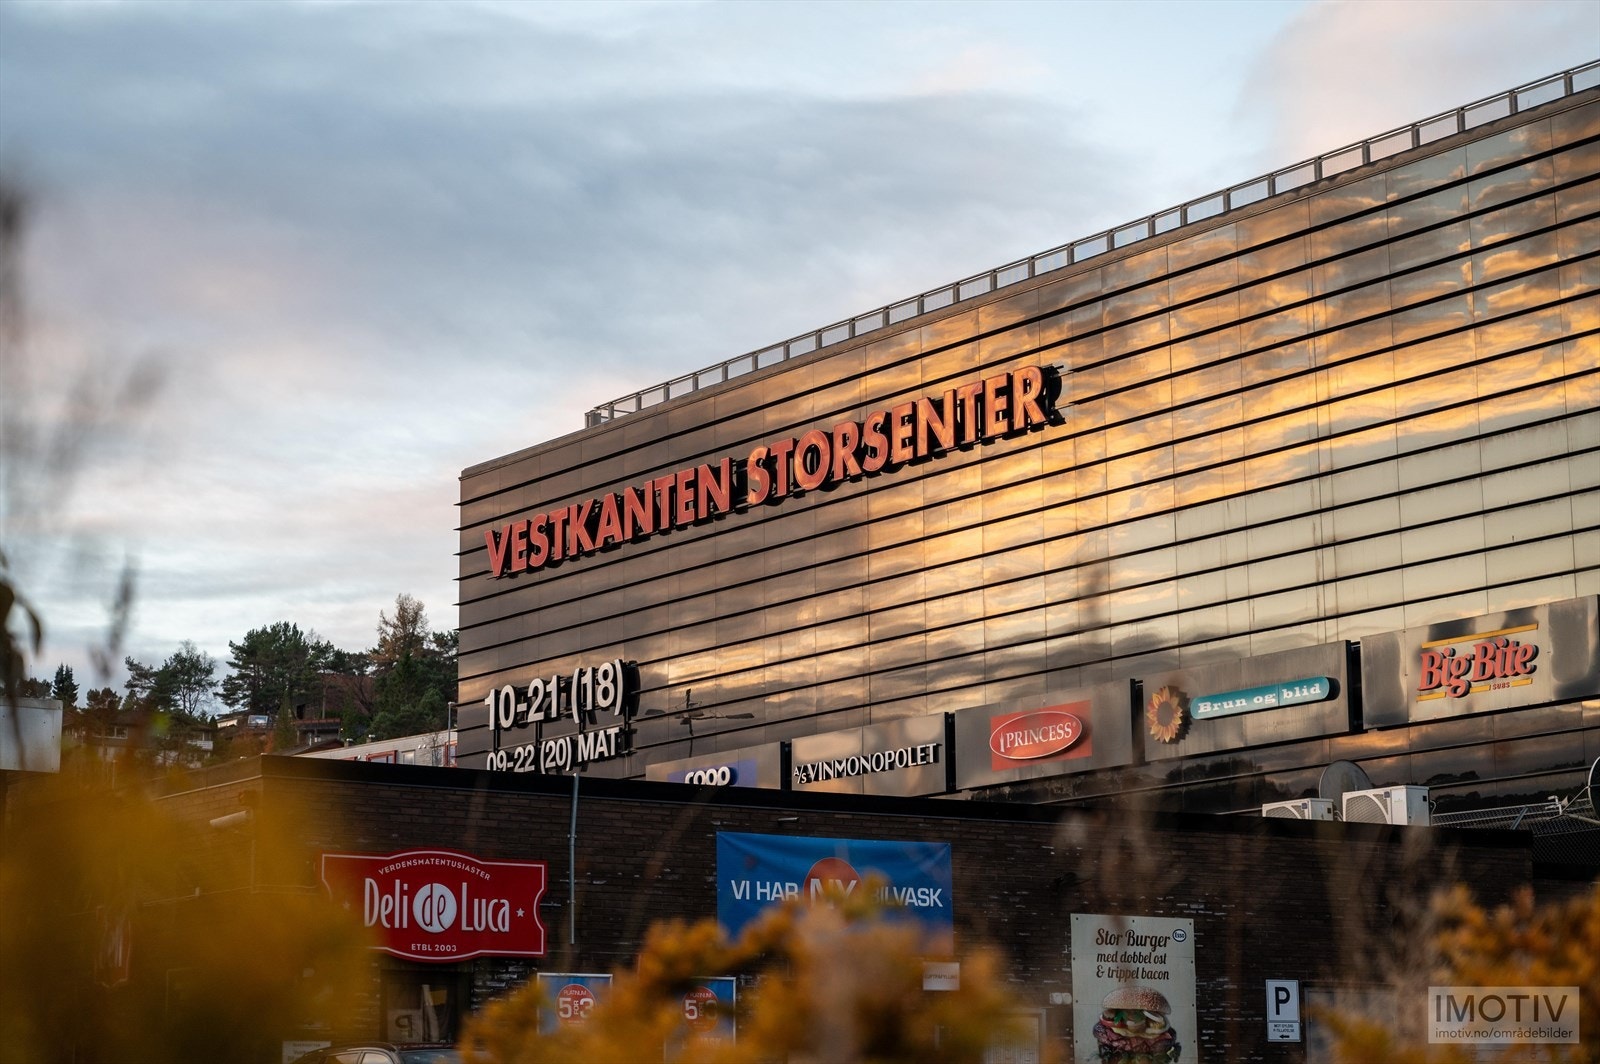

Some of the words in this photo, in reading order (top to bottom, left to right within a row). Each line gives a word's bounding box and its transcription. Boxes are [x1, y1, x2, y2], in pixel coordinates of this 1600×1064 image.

[484, 457, 733, 578] VESTKANTEN
[747, 366, 1048, 504] STORSENTER
[1417, 647, 1471, 698] Big
[1471, 637, 1536, 682] Bite
[484, 675, 559, 731] 10-21
[571, 659, 624, 724] (18)
[1197, 697, 1247, 714] Brun
[1252, 692, 1277, 706] og
[1281, 683, 1322, 699] blid
[1493, 682, 1511, 690] SUBS
[1004, 721, 1073, 749] PRINCESS
[540, 736, 573, 775] (20)
[577, 727, 620, 763] MAT
[807, 743, 938, 782] VINMONOPOLET
[378, 858, 491, 881] VERDENSMATENTUSIASTER
[731, 880, 750, 900] VI
[756, 881, 799, 901] HAR
[364, 877, 408, 930] Deli
[421, 883, 448, 930] de
[461, 882, 510, 933] Luca
[411, 943, 432, 951] ETBL
[434, 944, 457, 952] 2003
[1095, 928, 1123, 946] Stor
[1125, 929, 1171, 952] Burger
[1096, 951, 1118, 963] med
[1120, 951, 1152, 964] dobbel
[1153, 953, 1167, 965] ost
[1096, 965, 1105, 978] &
[1107, 966, 1140, 982] trippel
[1141, 967, 1170, 980] bacon
[559, 997, 572, 1018] 5
[580, 997, 594, 1019] 3
[685, 1000, 698, 1020] 5
[1275, 987, 1290, 1015] P
